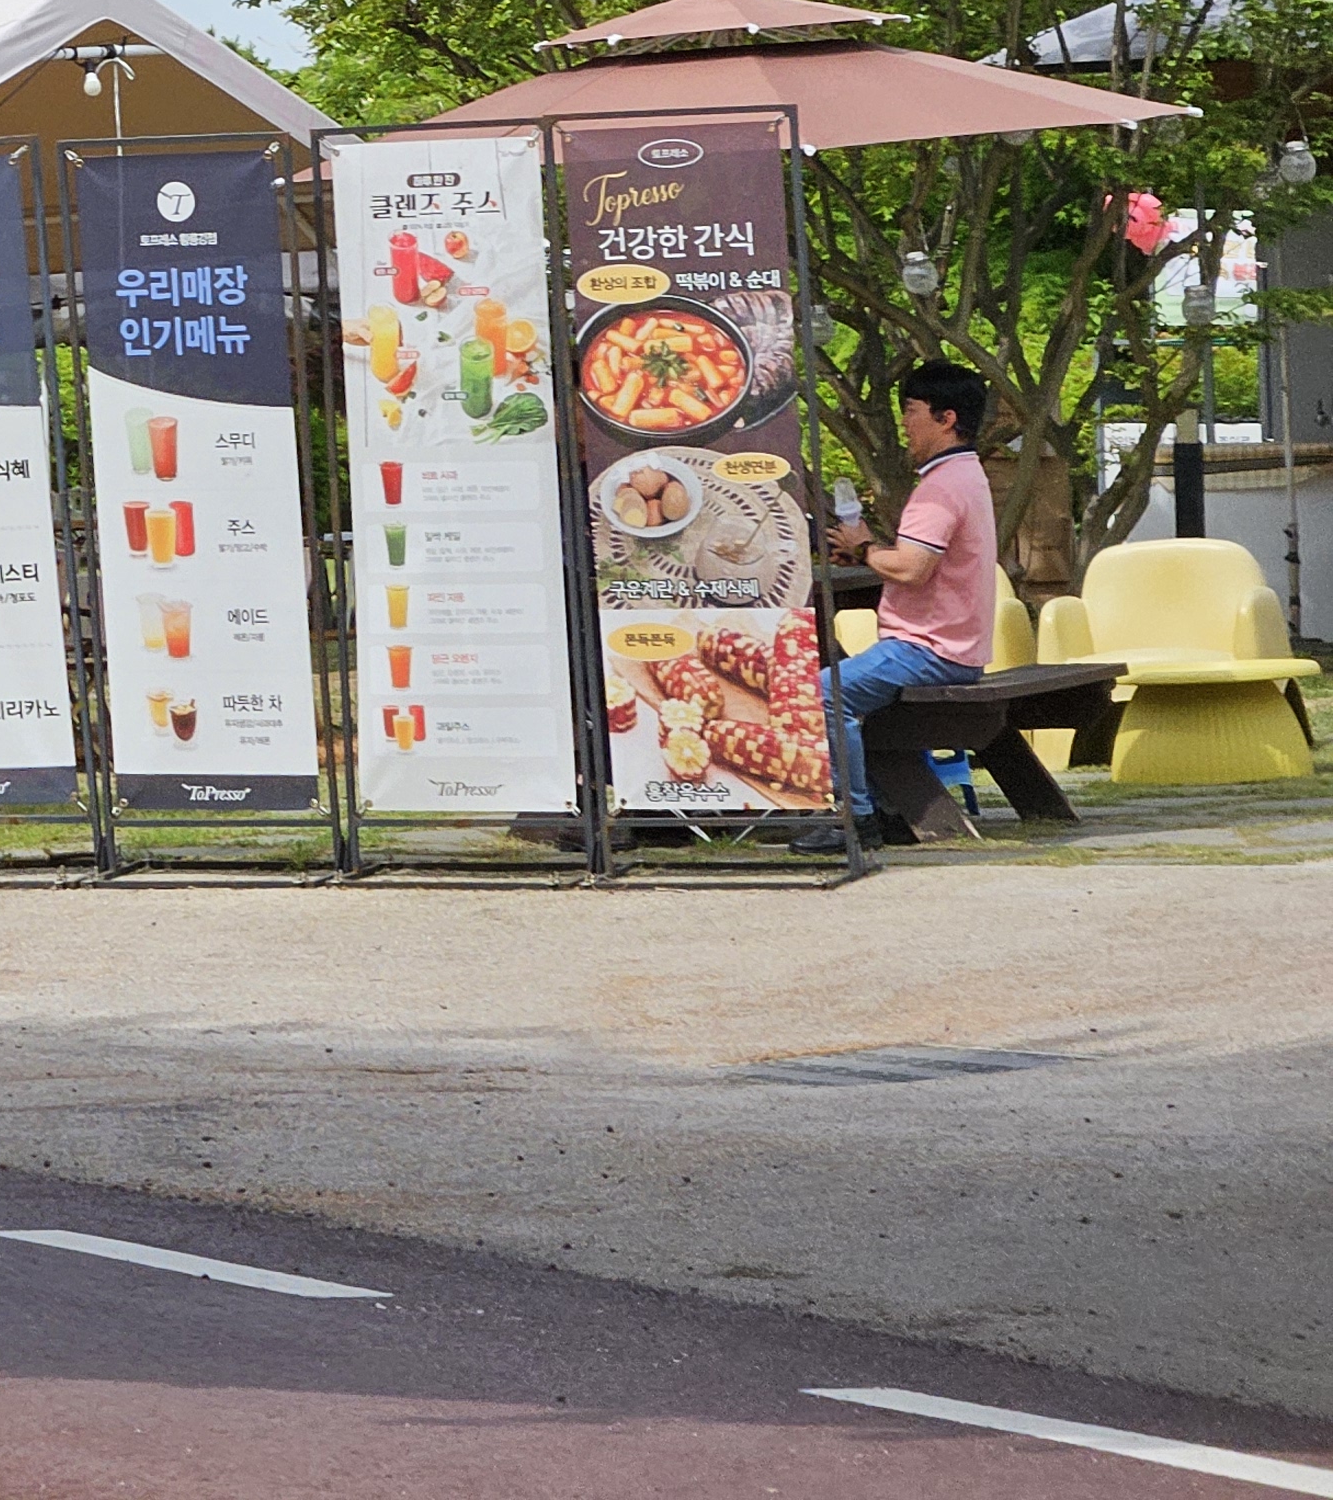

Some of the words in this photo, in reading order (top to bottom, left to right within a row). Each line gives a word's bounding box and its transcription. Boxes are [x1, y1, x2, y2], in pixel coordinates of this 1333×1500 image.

[370, 194, 443, 219] 클렌즈
[451, 191, 501, 216] 주스
[584, 170, 684, 226] Topresso
[598, 225, 688, 261] 건강한
[693, 222, 755, 257] 간식
[116, 265, 248, 308] 우리매장
[590, 276, 628, 291] 환상의
[631, 275, 657, 290] 조합
[676, 272, 726, 291] 떡볶이
[730, 274, 742, 287] &
[746, 269, 781, 289] 순대
[120, 316, 250, 356] 인기메뉴
[215, 432, 256, 450] 스무디
[724, 460, 777, 475] 천생연분
[227, 519, 256, 536] 주스
[609, 579, 674, 599] 구운계란
[678, 582, 690, 597] &
[694, 578, 760, 598] 수제식혜
[227, 608, 270, 626] 에이드
[268, 694, 283, 712] 차
[181, 783, 252, 802] ToPresso
[428, 778, 505, 797] ToPresso
[644, 780, 731, 803] 홍찰옥수수
